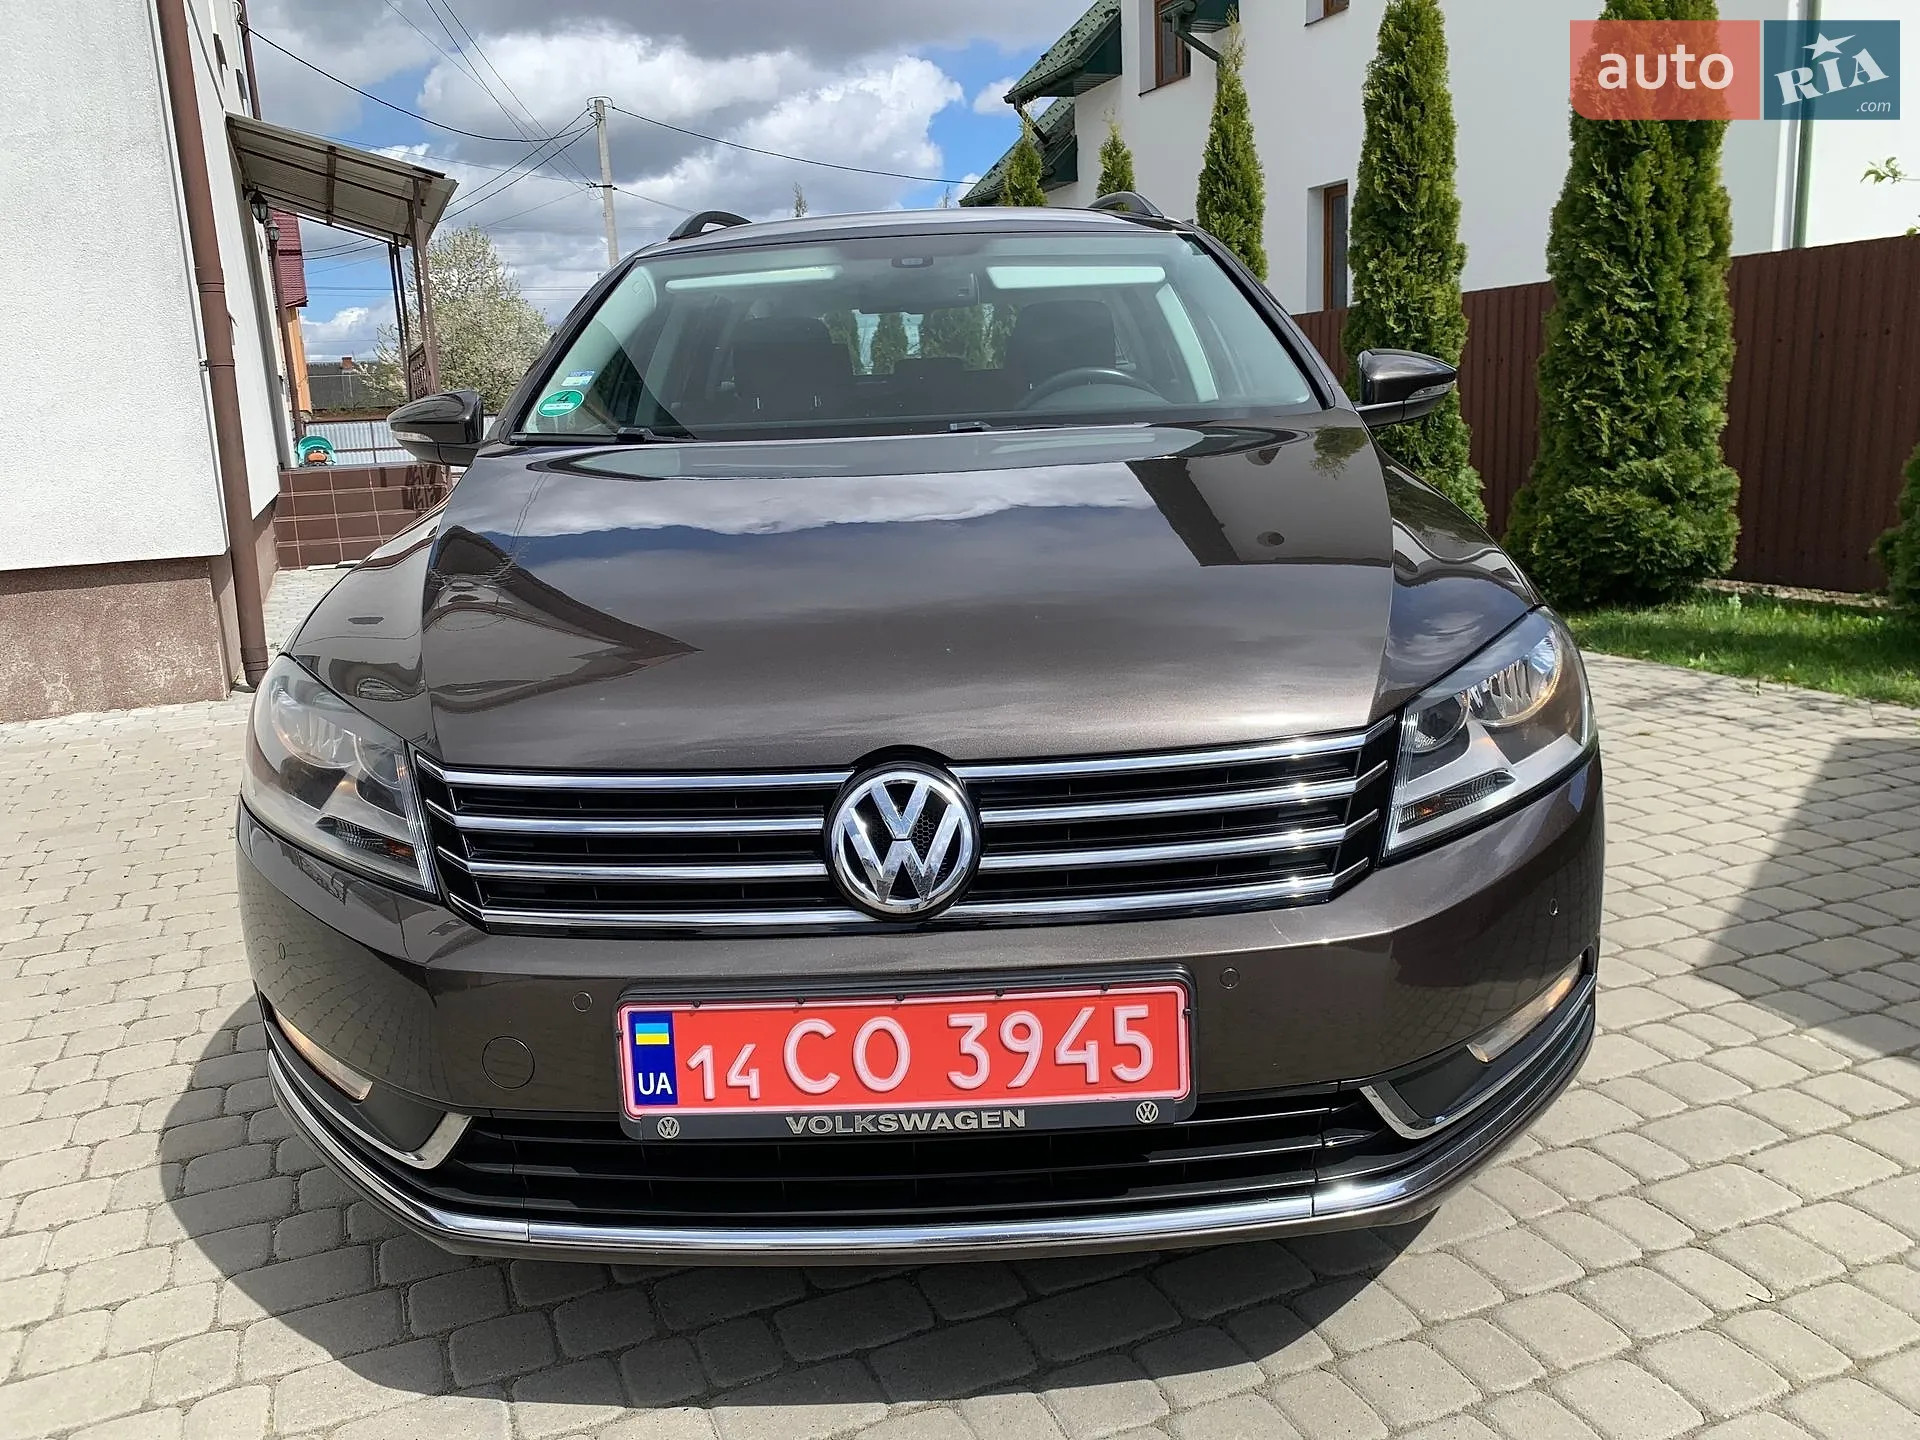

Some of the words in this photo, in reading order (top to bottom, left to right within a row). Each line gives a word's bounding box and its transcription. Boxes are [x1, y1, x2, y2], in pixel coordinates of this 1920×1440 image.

[686, 1044, 760, 1100] 14
[783, 1016, 911, 1094] CO
[947, 1004, 1153, 1090] 3945
[638, 1072, 673, 1095] UA
[785, 1109, 1026, 1135] VOLKSWAGEN
